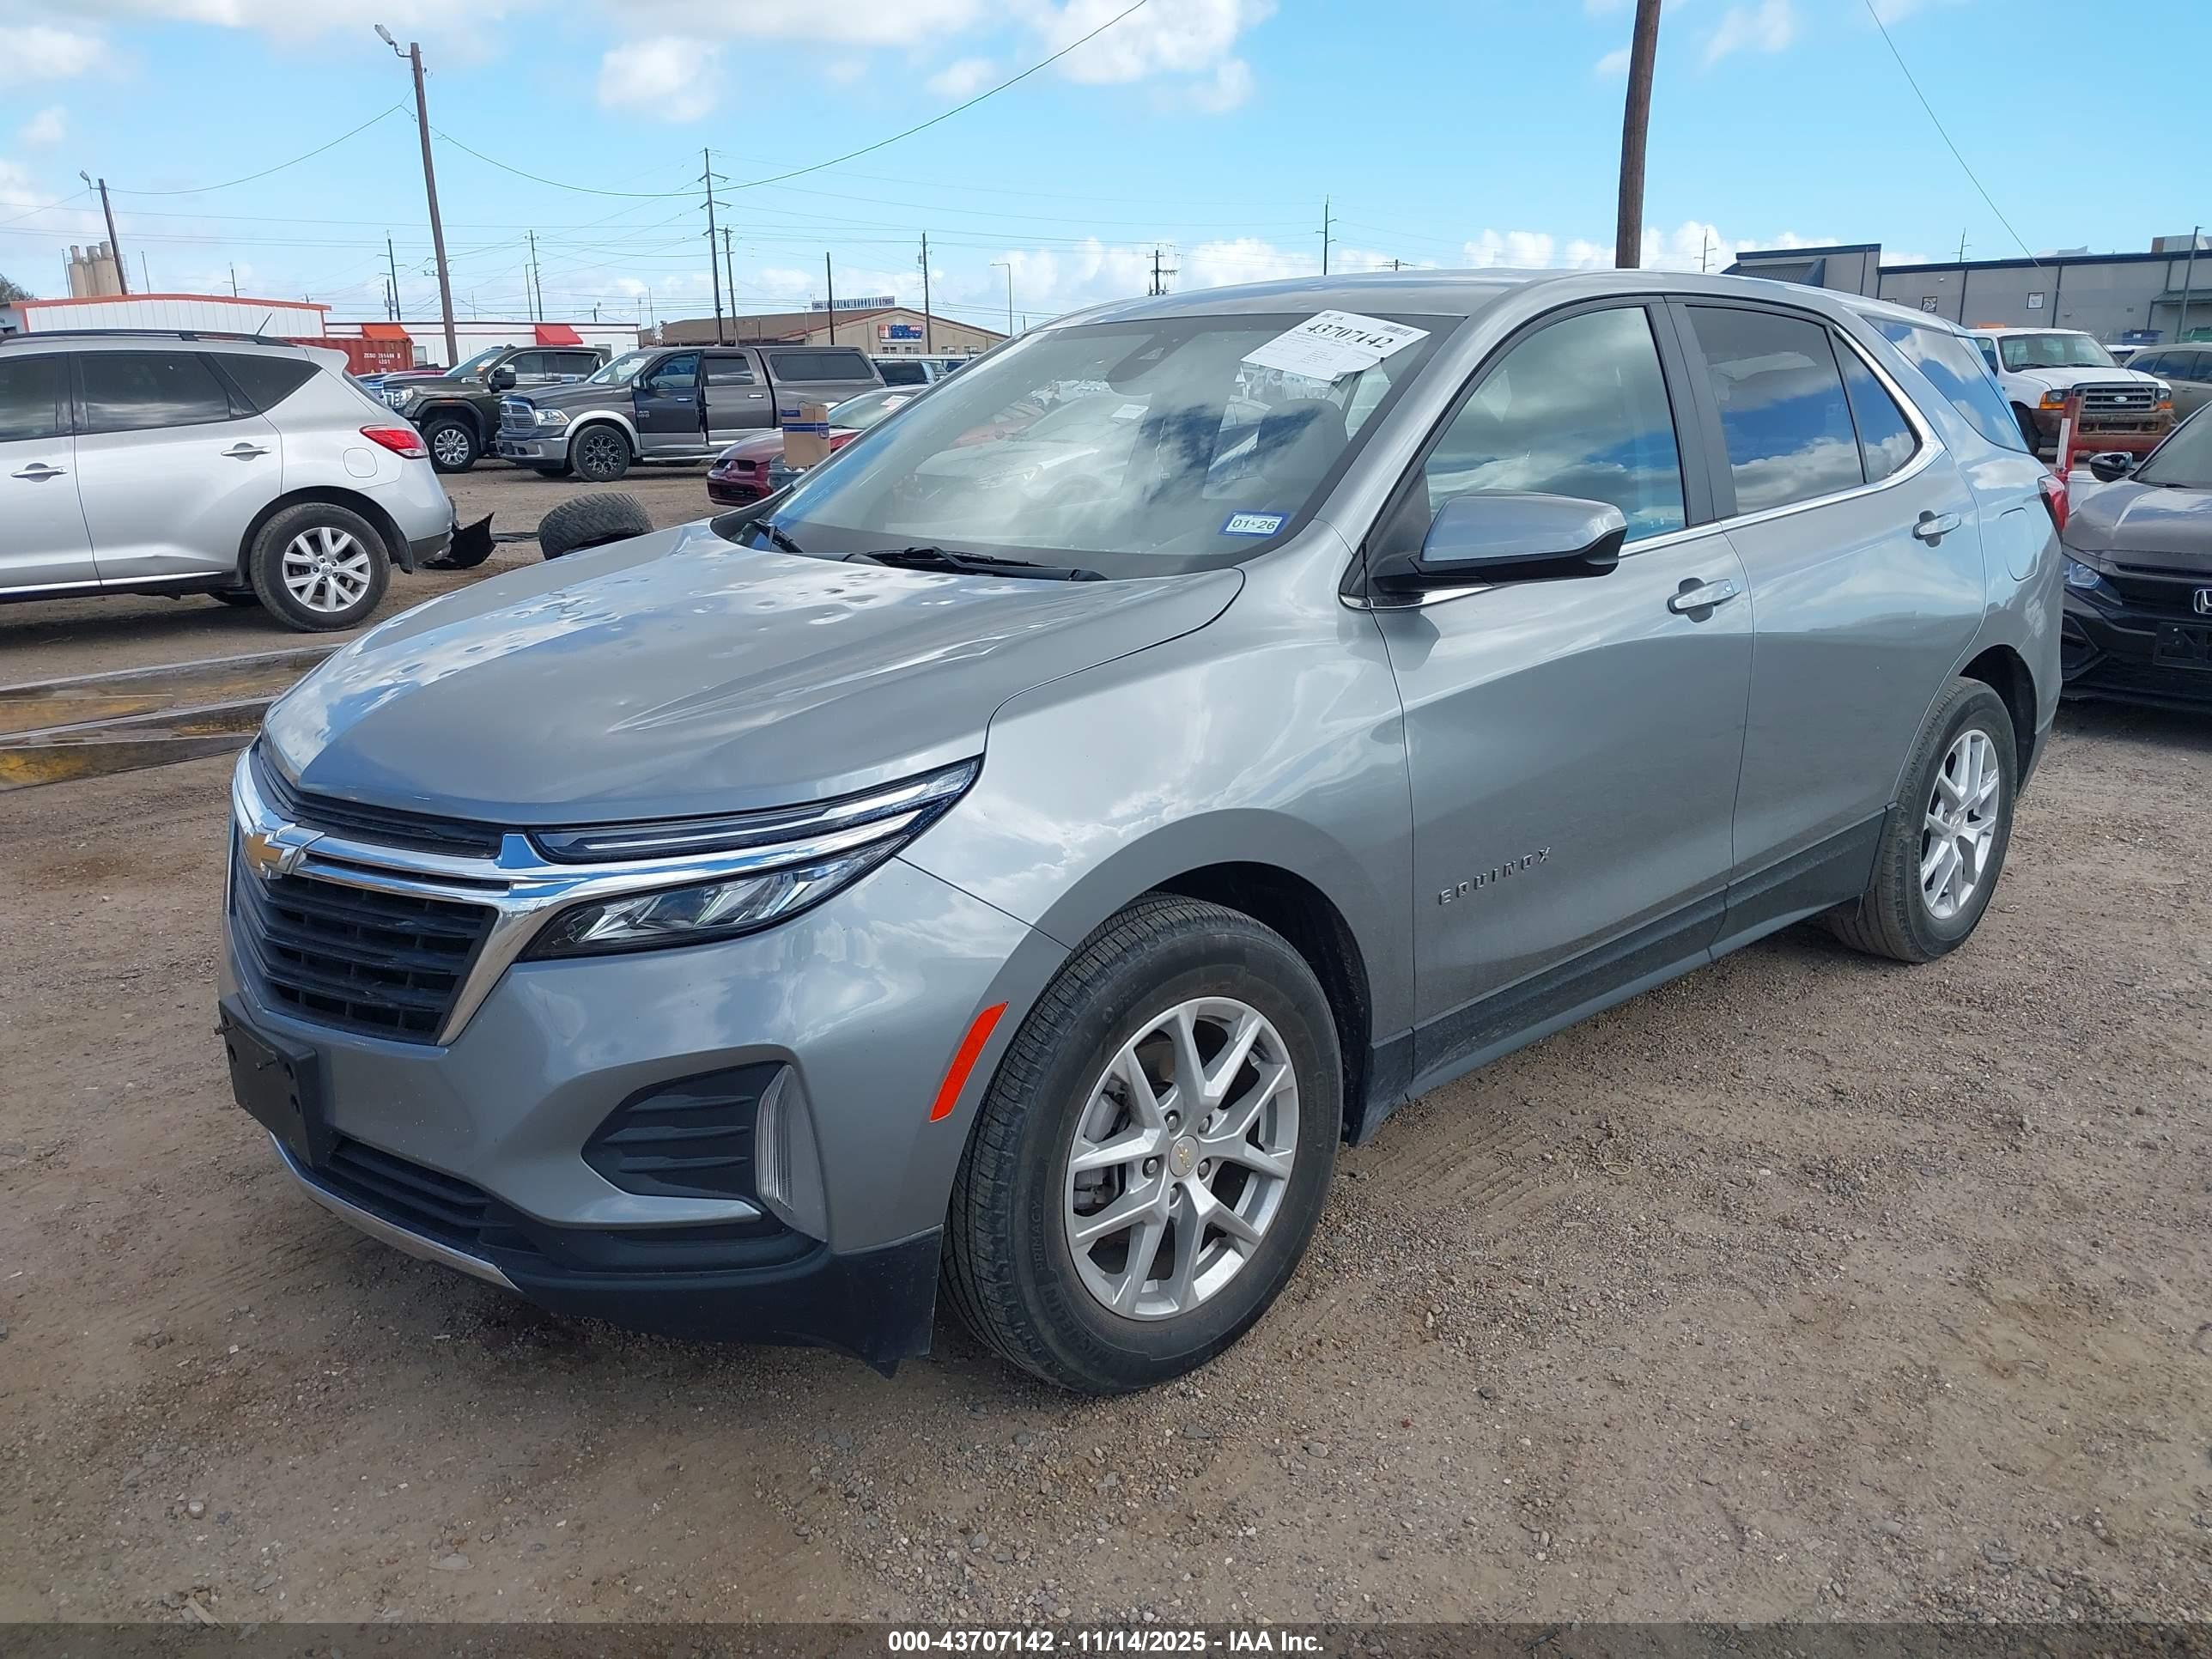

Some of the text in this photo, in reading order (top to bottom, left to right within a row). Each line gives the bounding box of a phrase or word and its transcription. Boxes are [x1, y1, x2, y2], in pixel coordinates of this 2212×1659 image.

[1306, 323, 1394, 349] 43707142
[1232, 519, 1277, 530] 01 26
[1438, 845, 1552, 905] EQUINOX
[1030, 1200, 1047, 1272] PRIMACY
